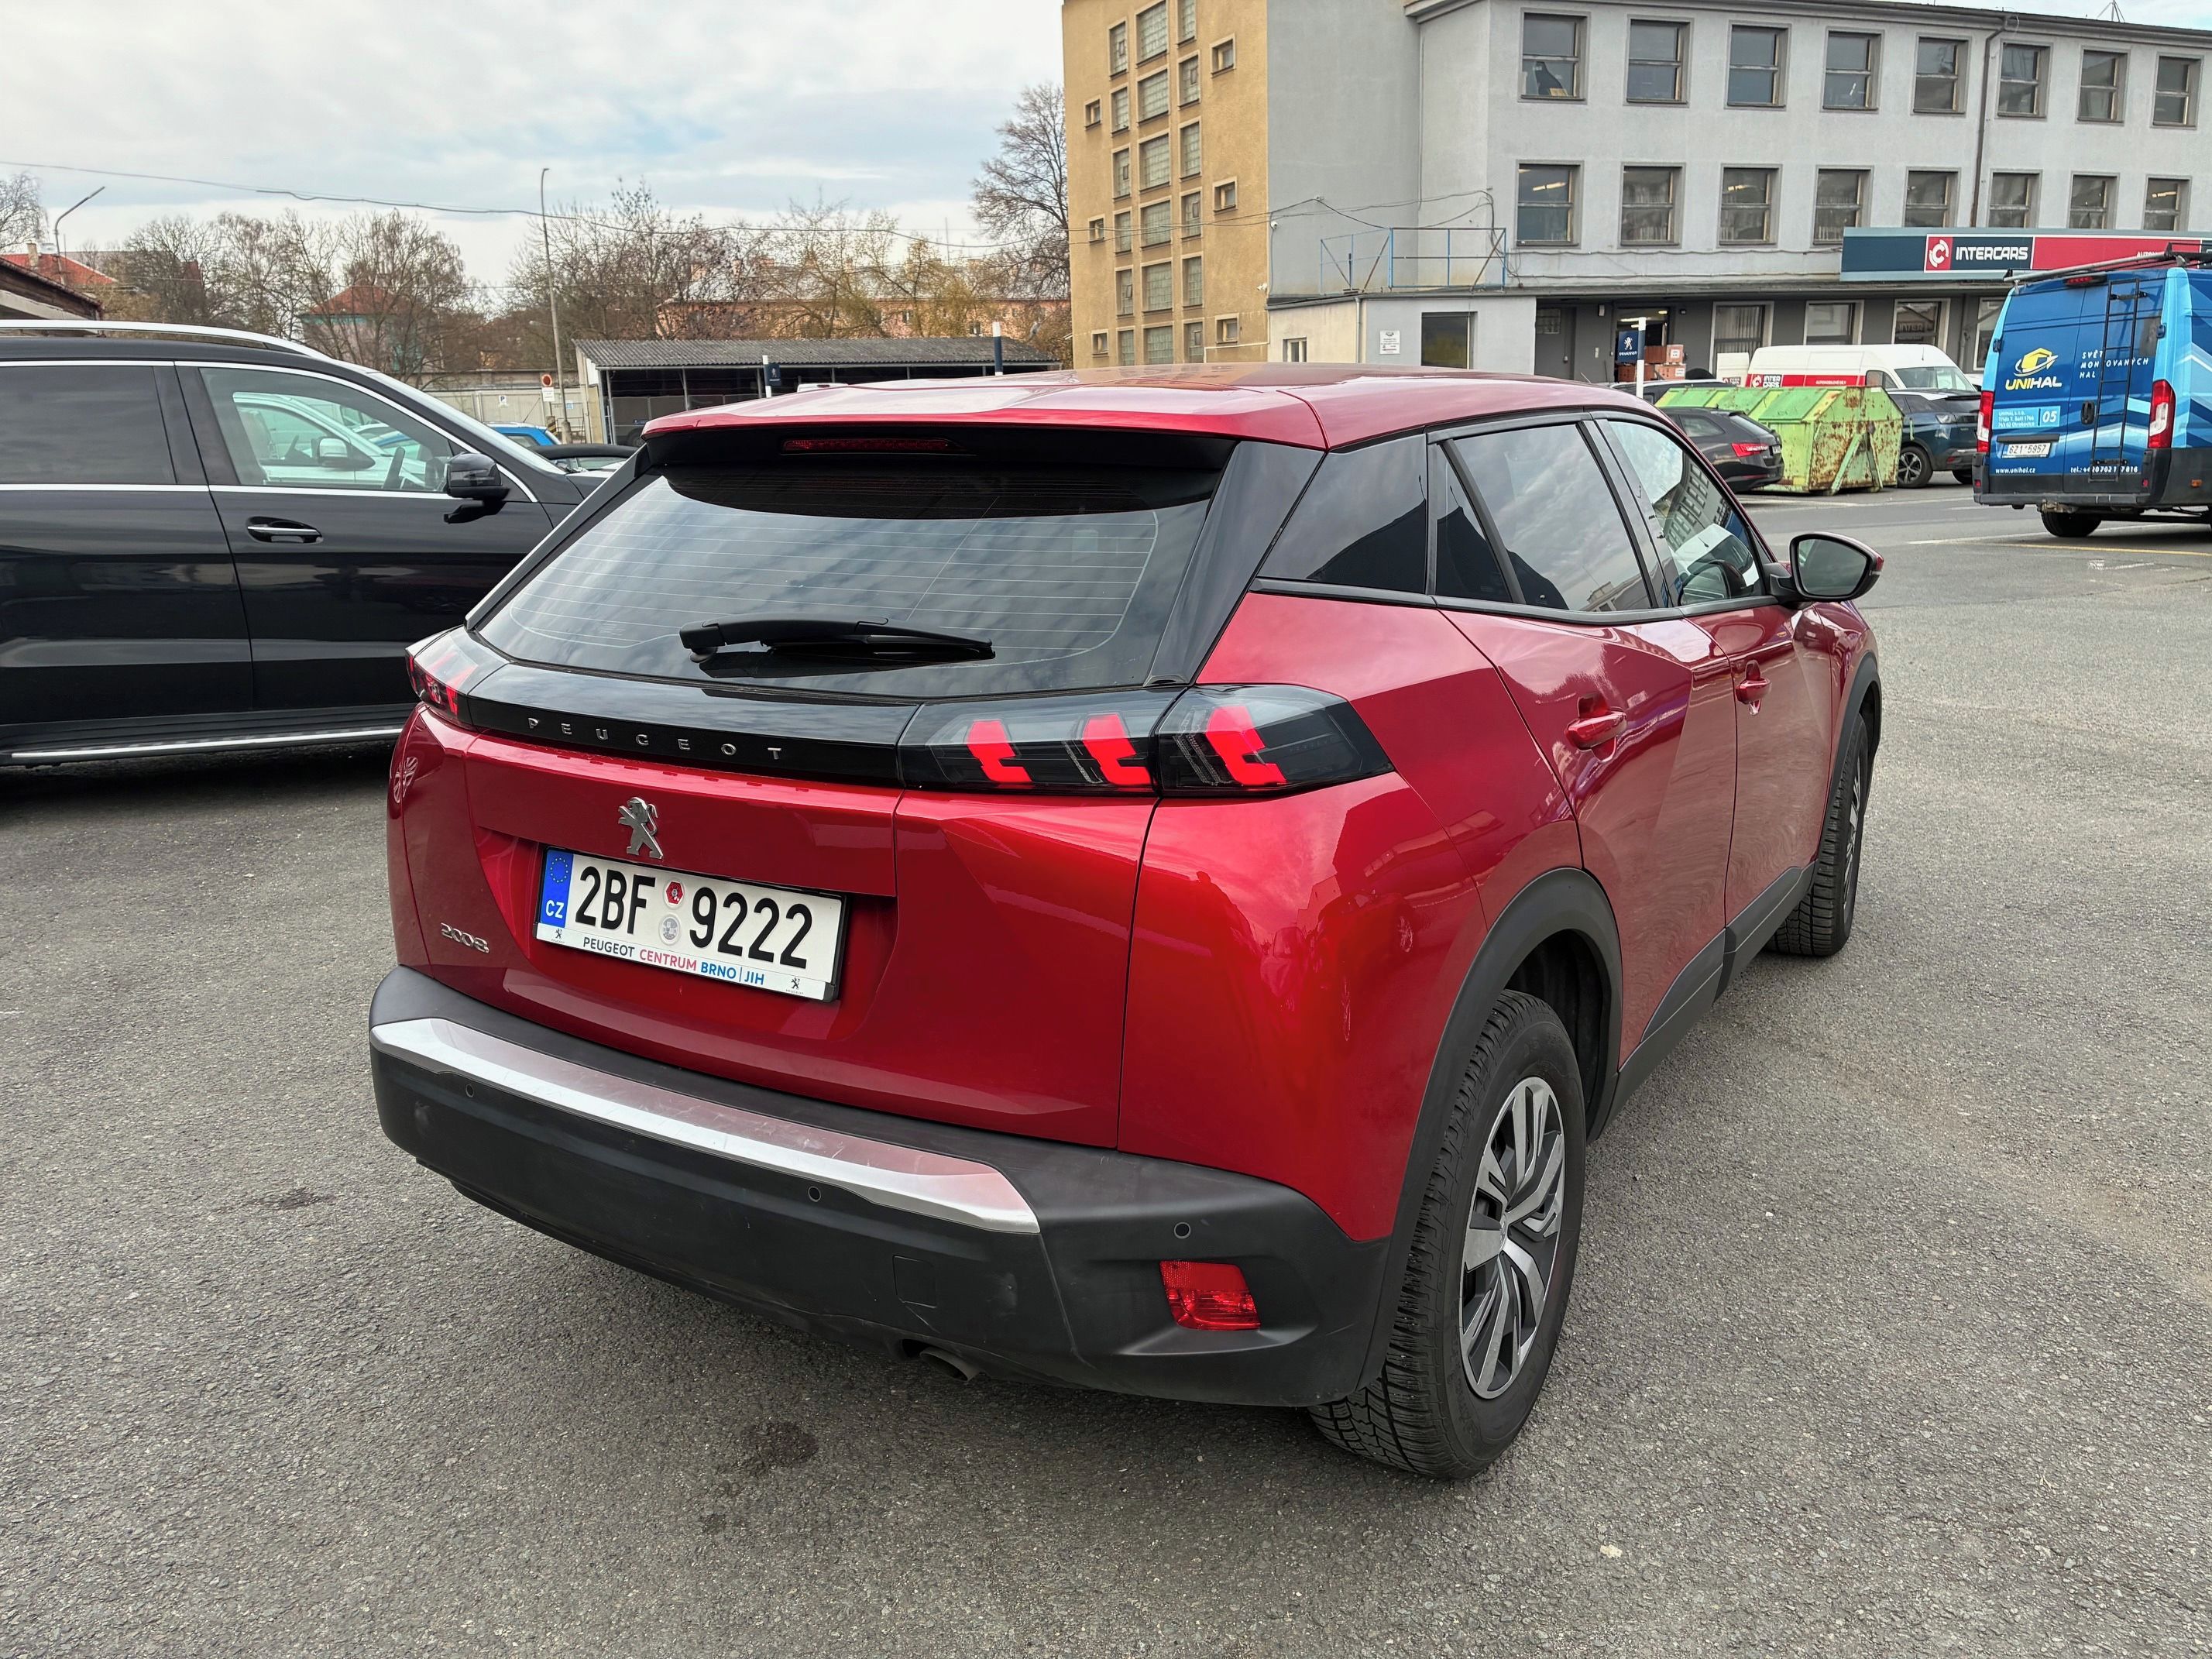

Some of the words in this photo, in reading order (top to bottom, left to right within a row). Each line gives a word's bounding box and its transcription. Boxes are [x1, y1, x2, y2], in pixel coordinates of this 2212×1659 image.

[1956, 246, 2028, 261] INTERCARS
[2080, 357, 2149, 369] MONOVANÝCH
[2005, 376, 2063, 390] UNIHAL
[2042, 410, 2058, 423] 05
[527, 717, 782, 760] PEUGEOT
[545, 901, 563, 919] CZ
[575, 866, 656, 934] 2BF
[689, 887, 812, 969] 9222
[583, 937, 635, 958] PEUGEOT
[640, 950, 697, 971] CENTRUM
[700, 962, 737, 980] BRNO
[744, 970, 764, 985] JIH
